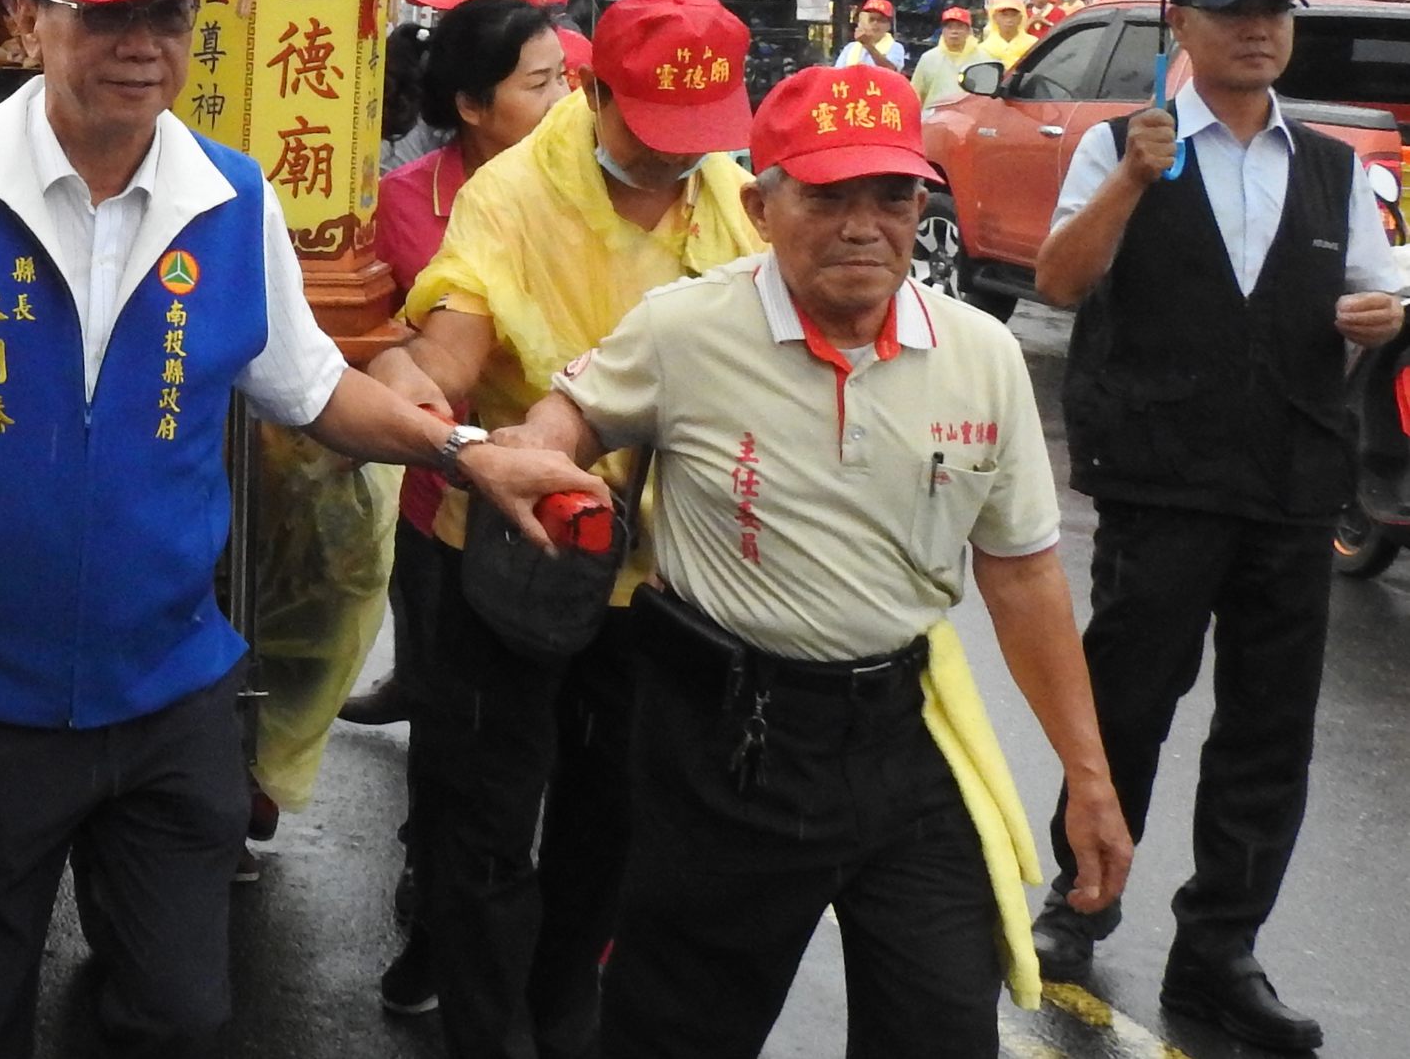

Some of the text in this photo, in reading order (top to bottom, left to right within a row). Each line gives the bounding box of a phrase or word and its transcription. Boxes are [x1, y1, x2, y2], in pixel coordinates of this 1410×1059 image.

[676, 45, 713, 64] 竹山
[655, 57, 730, 90] 靈德廟
[831, 80, 882, 99] 竹山
[811, 98, 902, 135] 靈德廟
[11, 256, 37, 321] 縣長
[155, 298, 188, 441] 南投縣政府
